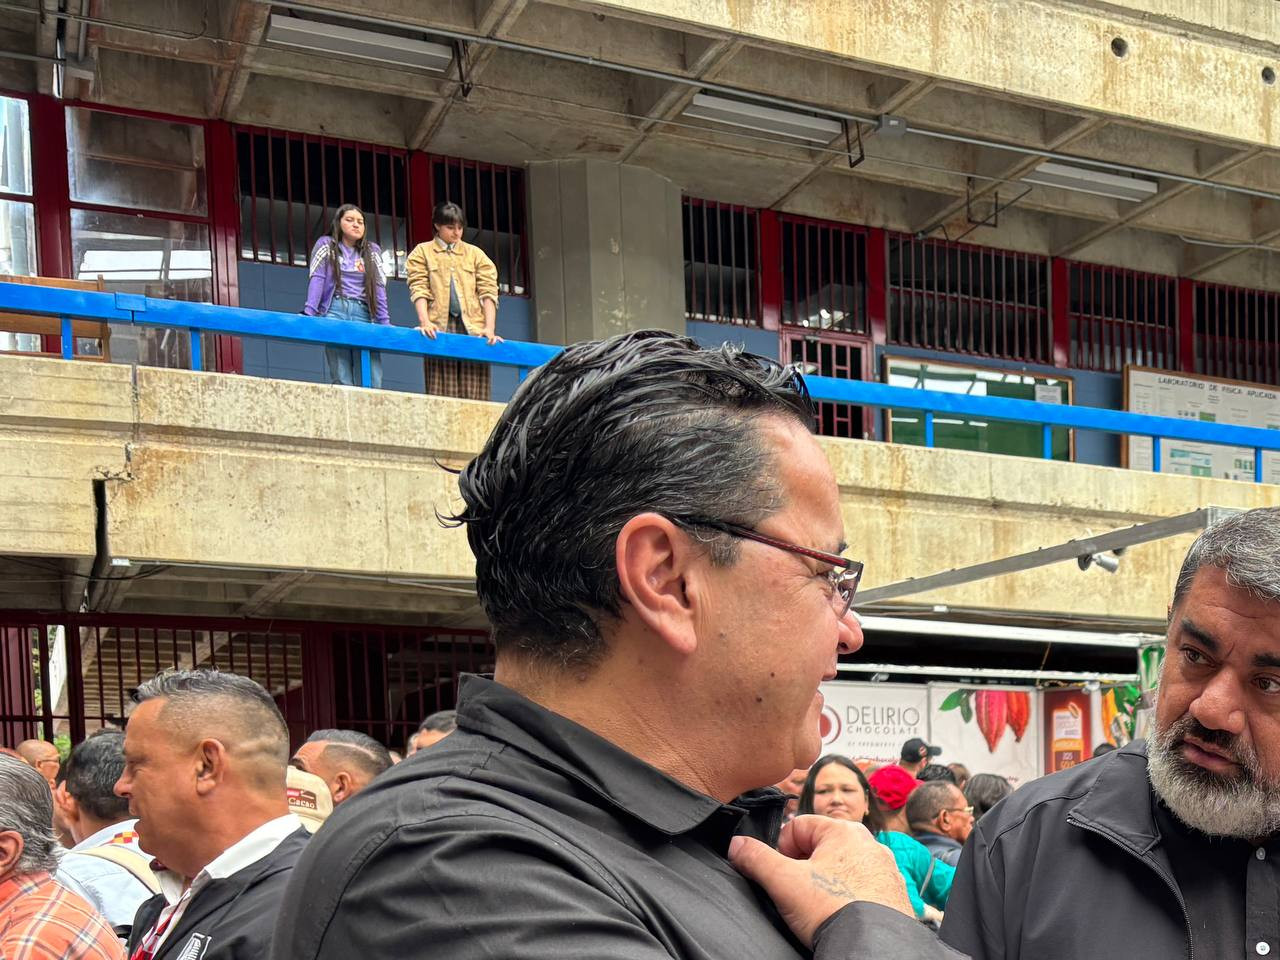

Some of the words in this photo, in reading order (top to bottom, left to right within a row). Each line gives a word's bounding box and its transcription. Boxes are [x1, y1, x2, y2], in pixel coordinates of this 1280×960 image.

[1158, 377, 1205, 389] LABORATORIO
[1208, 384, 1218, 392] DE
[1247, 389, 1277, 400] APLICADA
[847, 706, 920, 726] DELIRIO
[847, 726, 918, 735] CHOCOLATE
